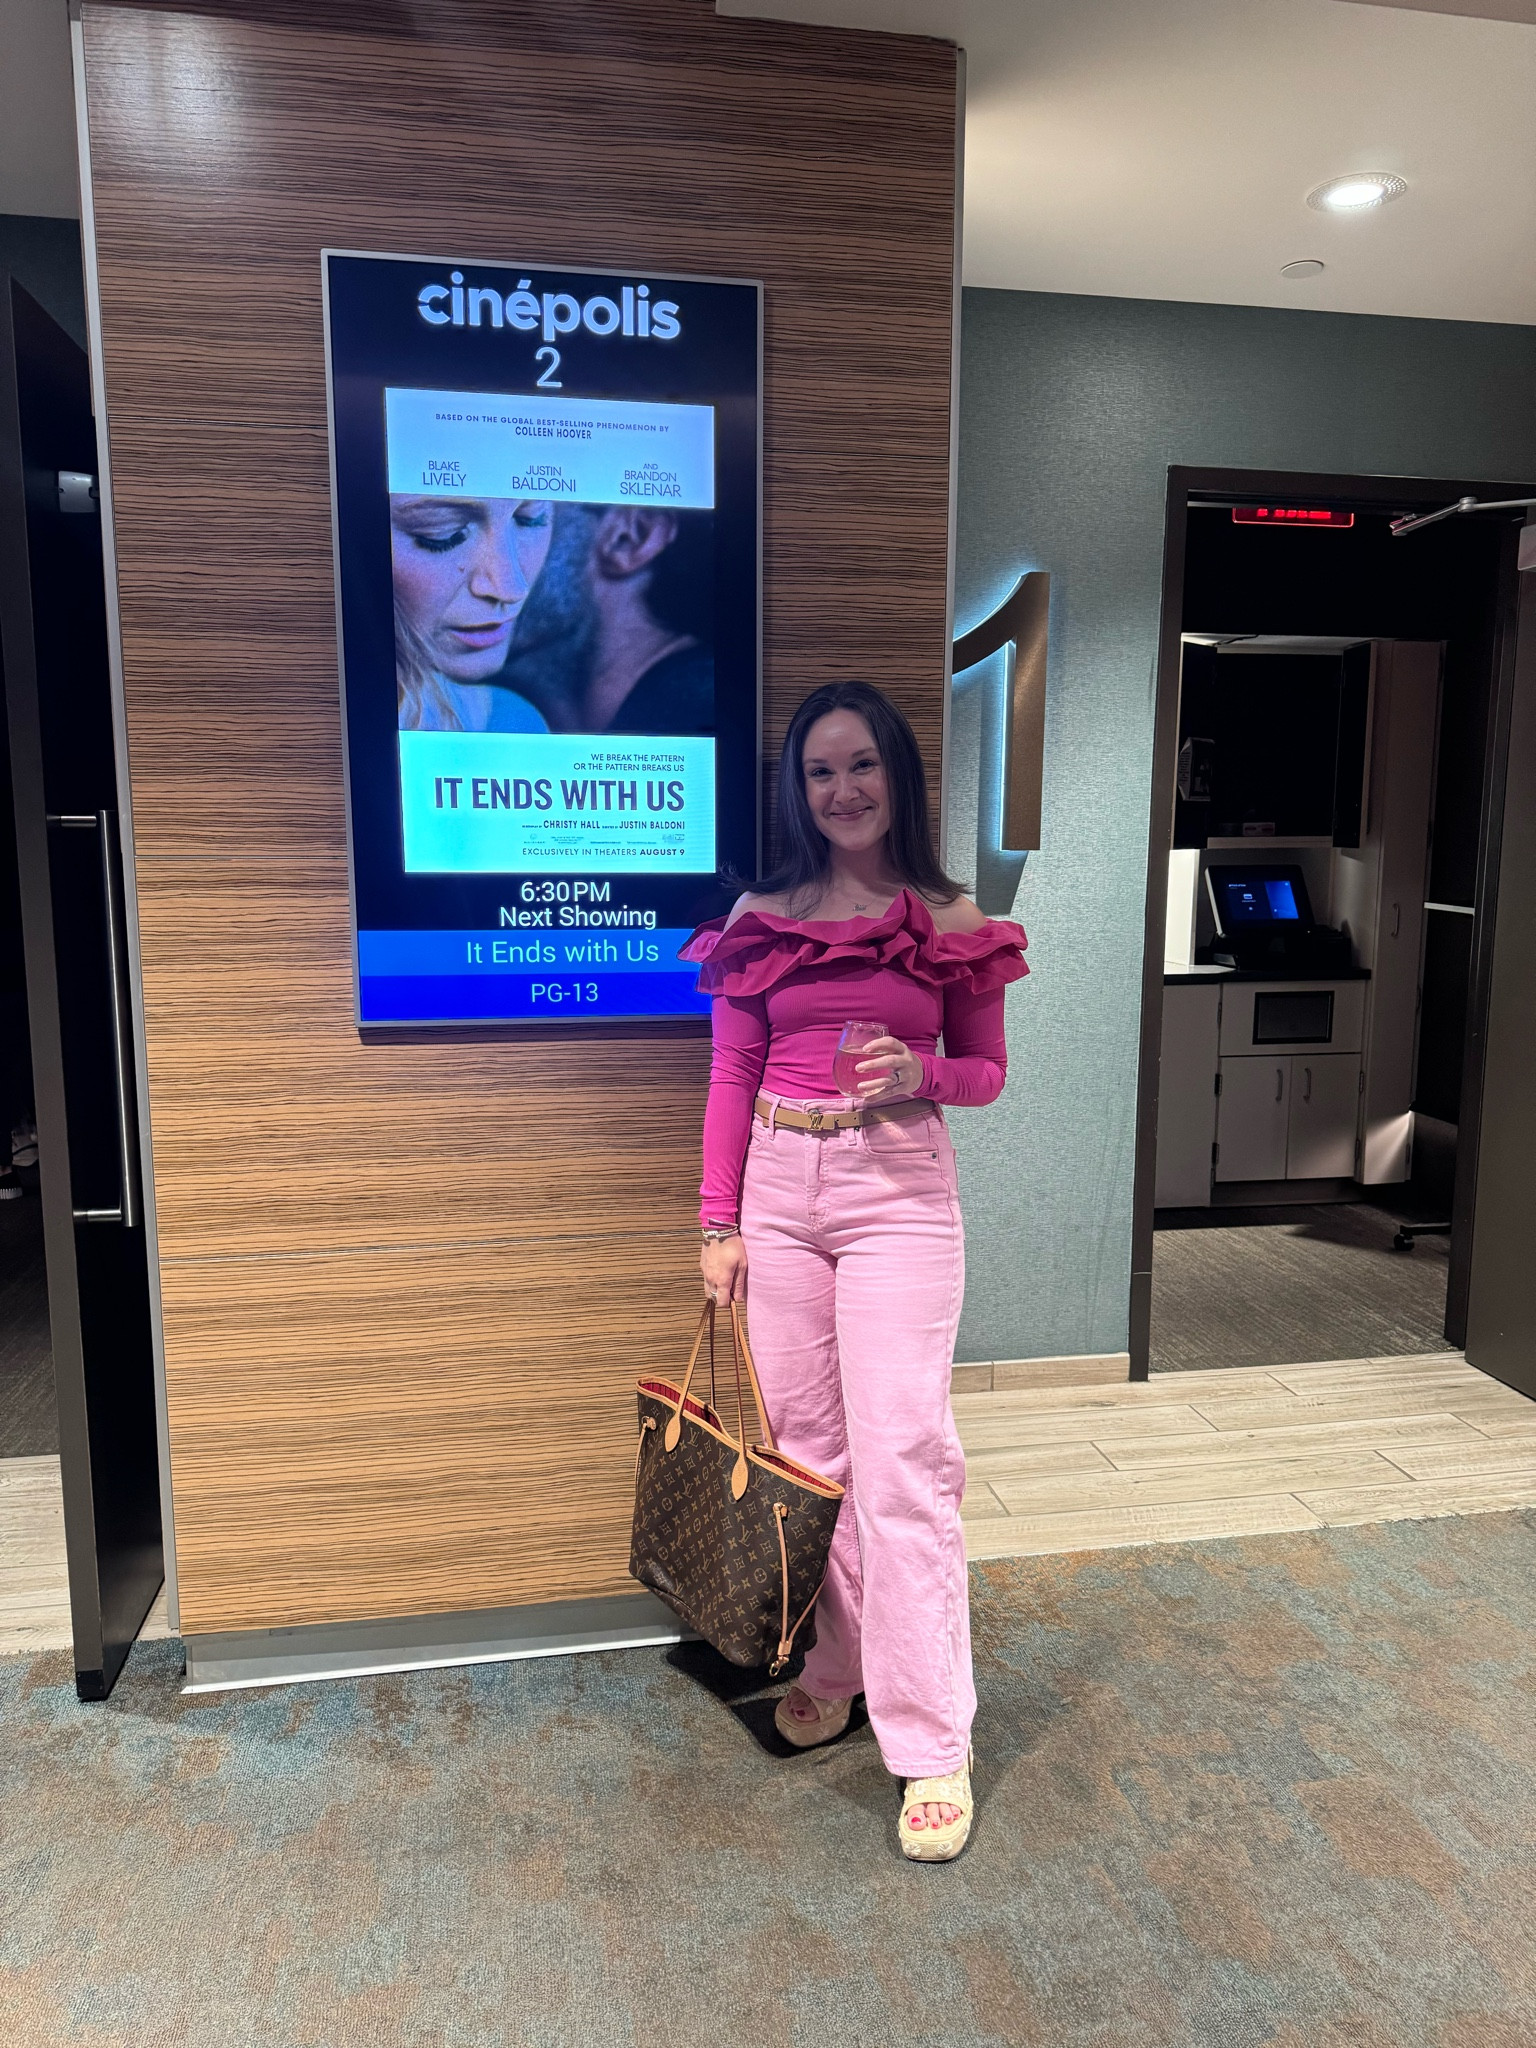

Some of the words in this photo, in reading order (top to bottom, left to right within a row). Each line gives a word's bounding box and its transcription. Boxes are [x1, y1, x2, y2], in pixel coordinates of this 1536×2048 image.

[417, 271, 682, 341] cinépolis
[535, 346, 563, 388] 2
[435, 413, 463, 421] BASED
[466, 414, 479, 422] ON
[482, 415, 498, 423] THE
[500, 416, 534, 425] GLOBAL
[536, 418, 594, 429] BEST-SELLING
[596, 421, 657, 432] PHENOMENON
[515, 426, 554, 437] COLLEEN
[556, 428, 592, 440] HOOVER
[428, 460, 460, 472] BLAKE
[526, 465, 562, 476] JUSTIN
[422, 472, 467, 487] LIVELY
[624, 470, 677, 482] BRANDON
[512, 476, 576, 493] BALDONI
[619, 481, 682, 497] SKLENAR
[952, 571, 1050, 850] 1
[591, 753, 605, 761] WE
[606, 753, 632, 761] BREAK
[634, 754, 649, 762] THE
[650, 754, 685, 762] PATTERN
[588, 763, 603, 771] THE
[605, 763, 640, 771] PATTERN
[641, 764, 672, 772] BREAKS
[673, 764, 685, 772] US
[435, 777, 463, 808] IT
[472, 778, 552, 810] ENDS
[560, 779, 637, 810] WITH
[647, 780, 685, 811] US
[543, 820, 578, 829] CHRISTY
[580, 821, 601, 829] HALL
[619, 821, 647, 829] JUSTIN
[650, 821, 685, 830] BALDONI
[522, 848, 579, 856] EXCLUSIVELY
[582, 848, 592, 856] IN
[595, 848, 637, 856] THEATERS
[639, 848, 677, 856] AUGUST
[500, 906, 553, 927] Next
[559, 904, 657, 930] Showing
[467, 941, 483, 963] It
[492, 939, 556, 963] Ends
[564, 939, 618, 962] with
[626, 940, 659, 962] Us
[531, 982, 599, 1003] PG-13
